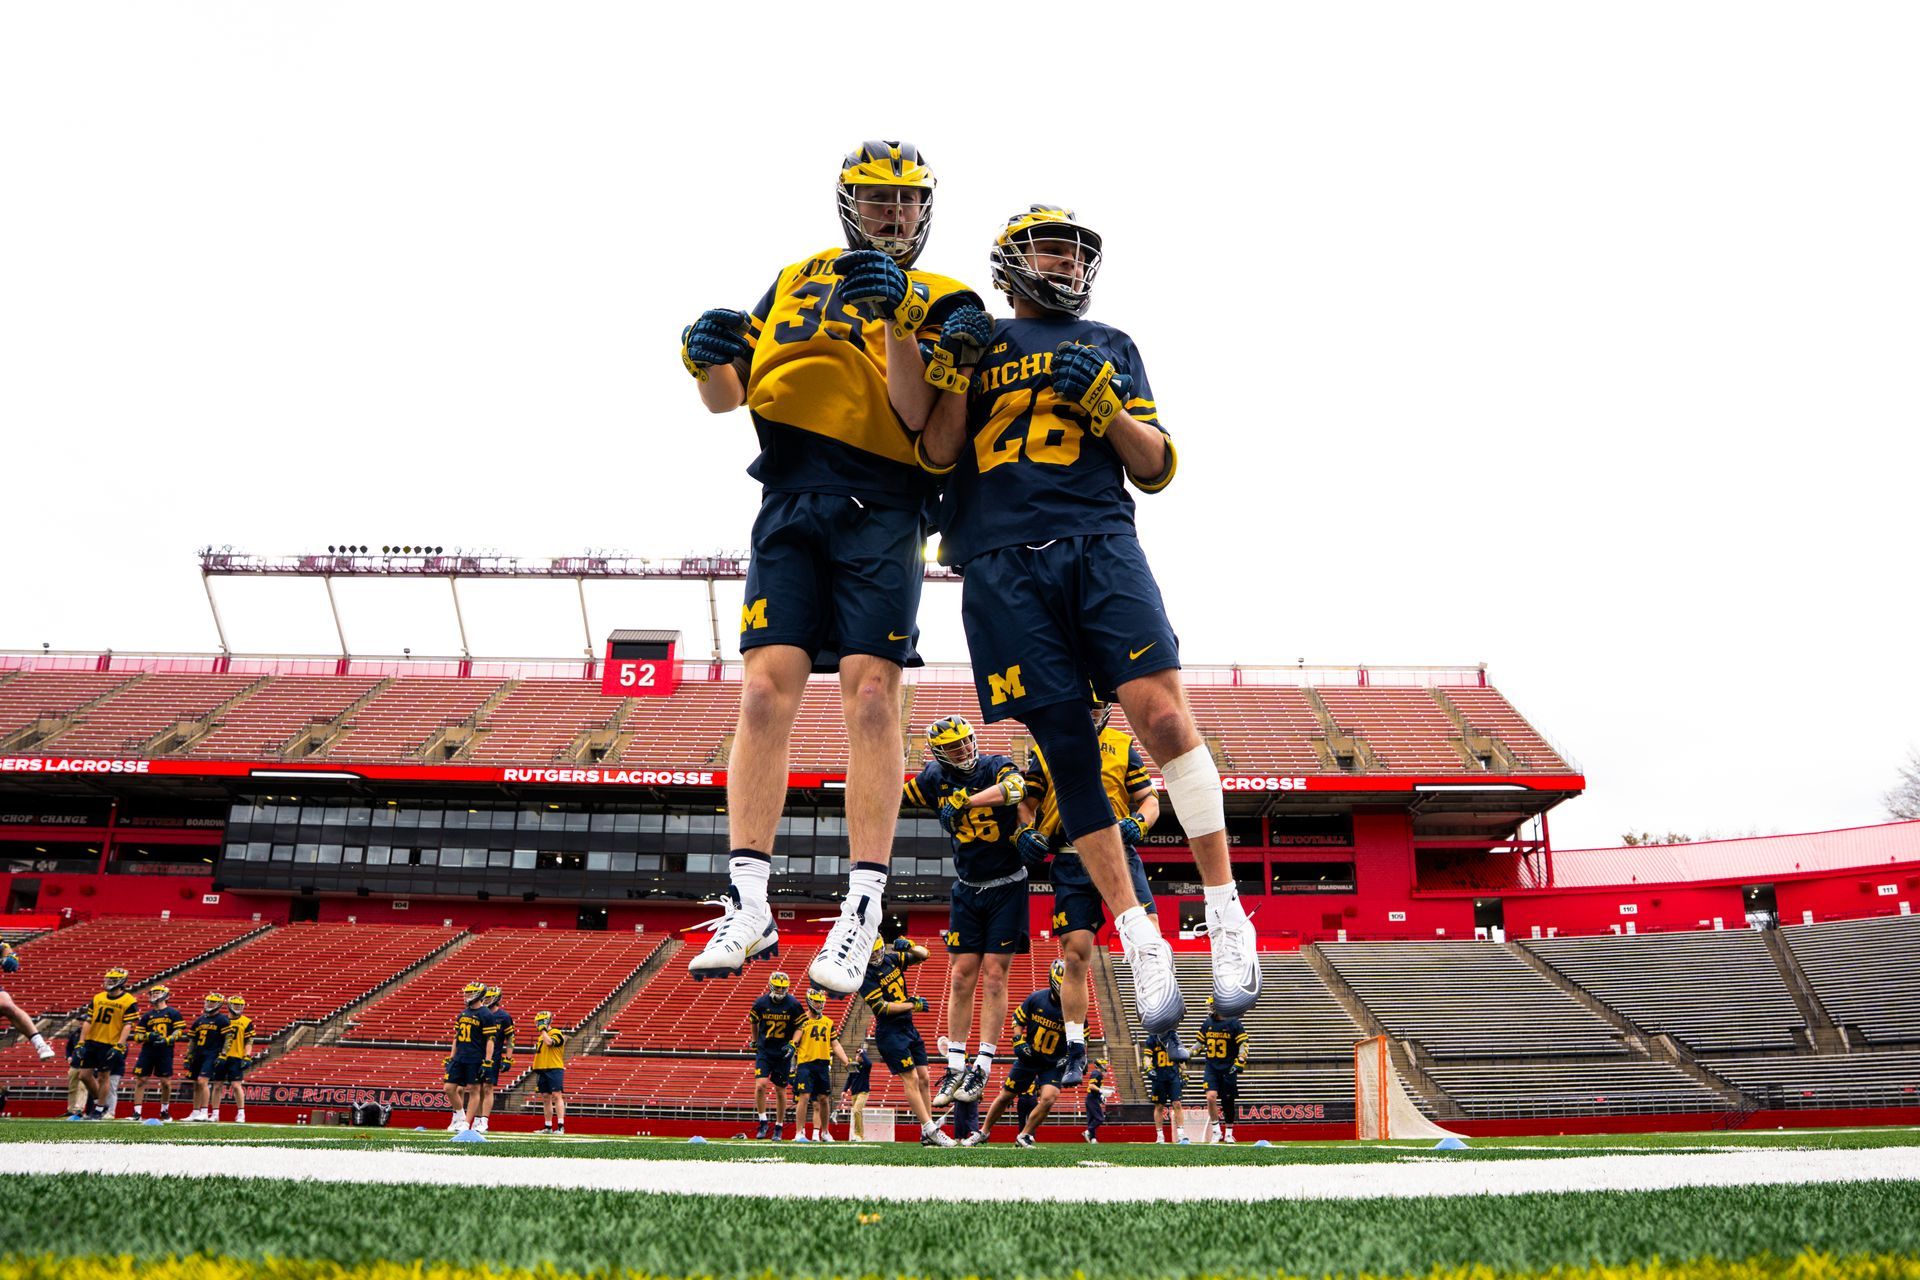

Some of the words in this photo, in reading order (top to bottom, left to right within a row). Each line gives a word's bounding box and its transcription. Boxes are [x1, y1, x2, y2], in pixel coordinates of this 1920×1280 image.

[981, 352, 1055, 395] MICHI
[974, 388, 1086, 474] 26
[741, 598, 768, 634] M
[619, 663, 656, 687] 52
[988, 664, 1026, 706] M
[0, 758, 42, 771] ERS
[44, 759, 150, 773] LACROSSE
[504, 768, 599, 783] RUTGERS
[603, 771, 713, 785] LACROSSE
[1220, 777, 1307, 790] CROSSE
[40, 815, 88, 824] CHANGE
[1052, 911, 1069, 930] M
[947, 931, 960, 947] M
[95, 1006, 115, 1025] 16
[457, 1023, 472, 1043] 31
[765, 1020, 787, 1039] 22
[809, 1025, 827, 1042] 44
[1206, 1038, 1227, 1058] 33
[221, 1085, 271, 1101] HME
[275, 1087, 299, 1101] OF
[302, 1087, 376, 1104] RUTGERS
[380, 1090, 452, 1107] LACROSS
[1238, 1104, 1325, 1120] LACROSSE
